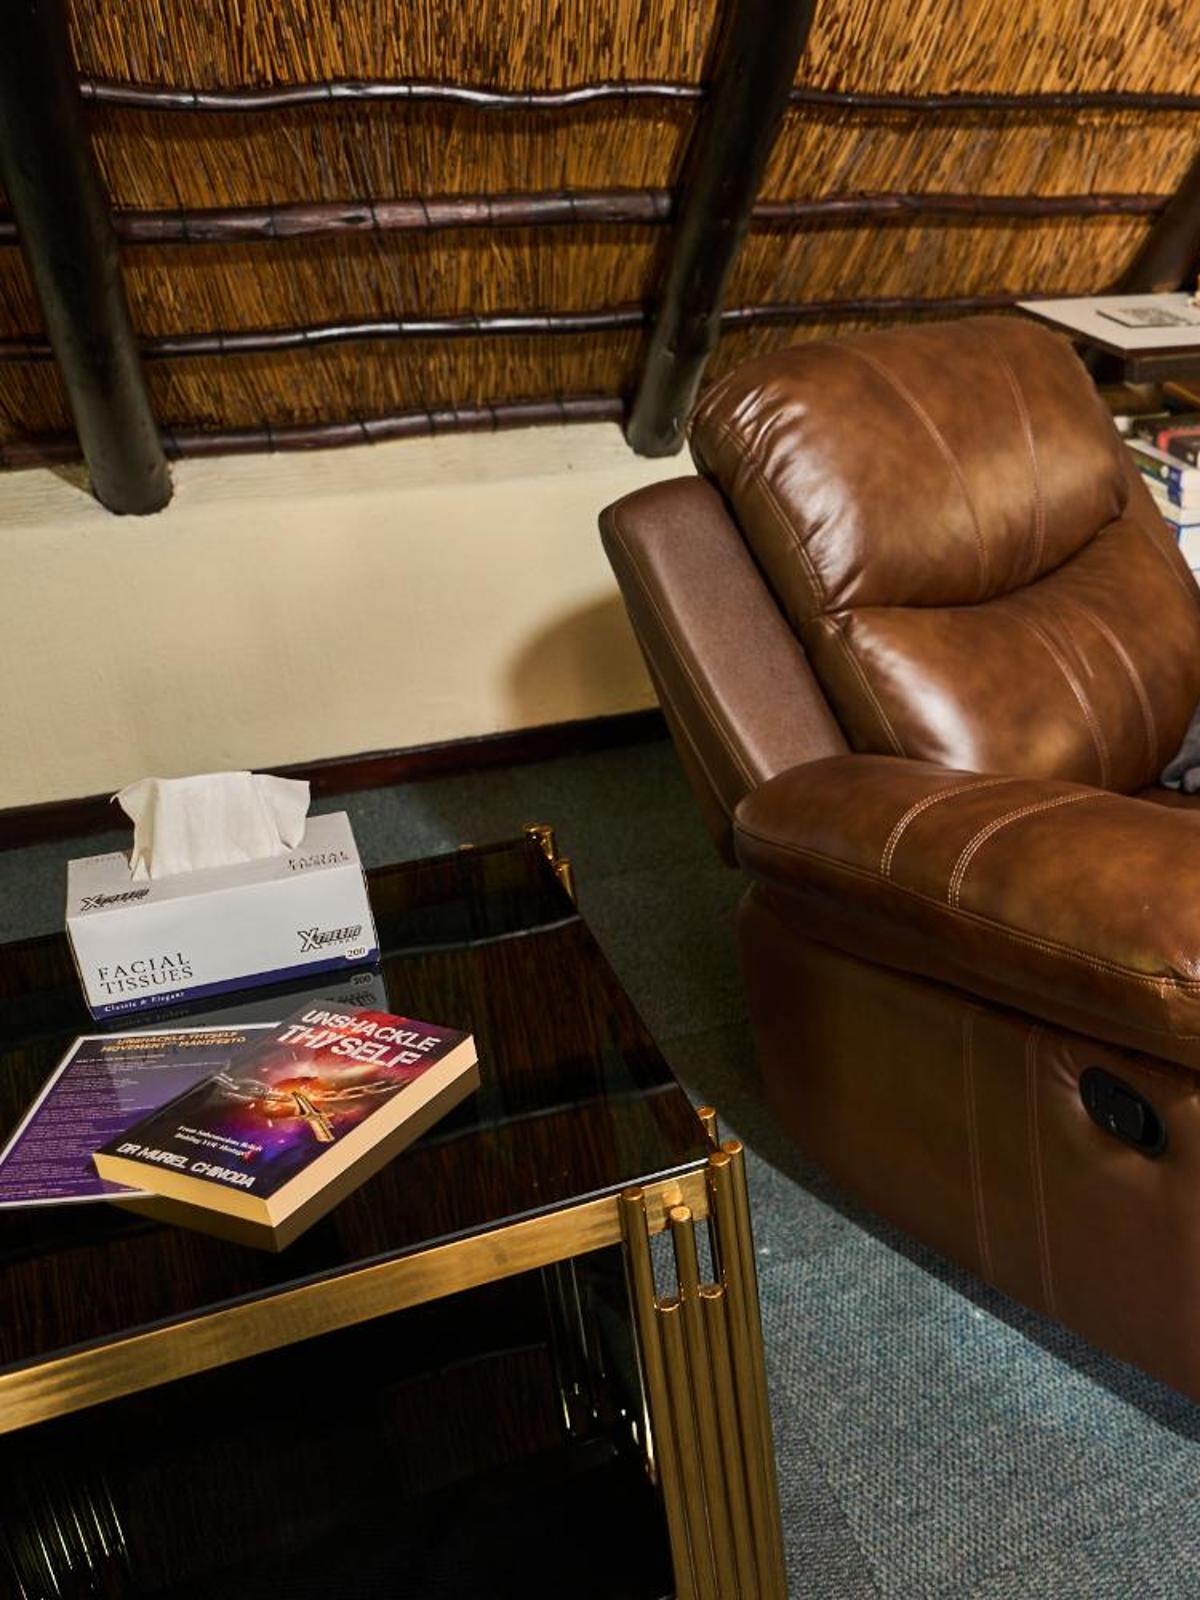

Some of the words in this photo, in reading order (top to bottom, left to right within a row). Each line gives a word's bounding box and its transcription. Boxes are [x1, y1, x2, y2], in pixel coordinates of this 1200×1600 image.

[98, 952, 190, 981] FACIAL
[100, 965, 193, 995] TISSUES
[277, 1024, 422, 1068] THYSELF
[301, 1009, 442, 1052] UNSHACKLE
[116, 1142, 138, 1155] DR
[138, 1147, 190, 1169] MURIEL
[190, 1162, 256, 1188] CHINODA
